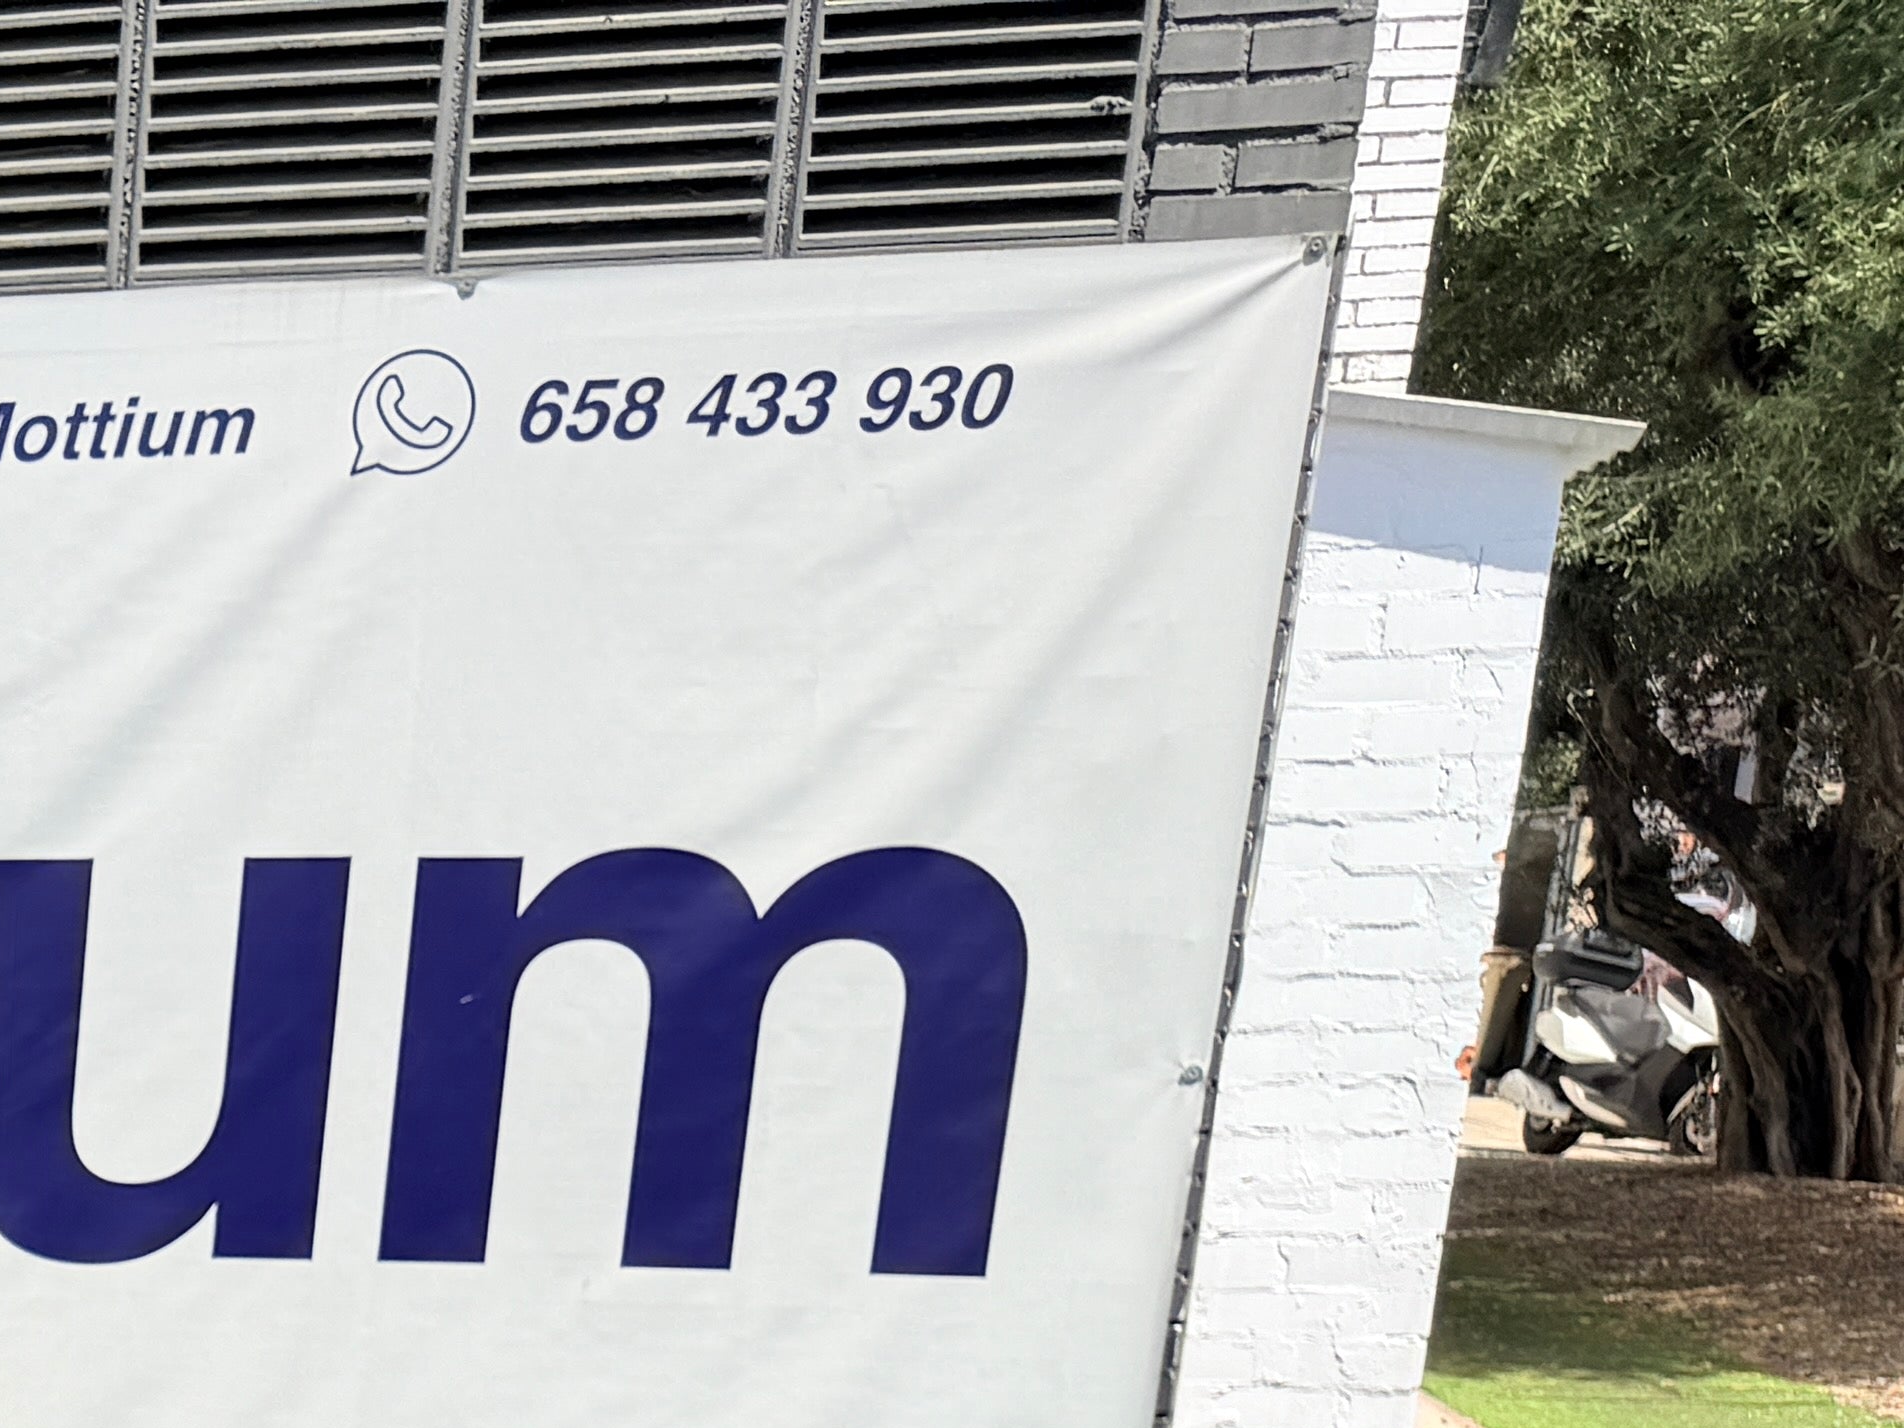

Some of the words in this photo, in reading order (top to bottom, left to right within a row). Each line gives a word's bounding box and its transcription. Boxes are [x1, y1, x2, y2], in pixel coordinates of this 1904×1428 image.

[520, 377, 665, 444] 658
[686, 370, 838, 437] 433
[859, 363, 1014, 433] 930
